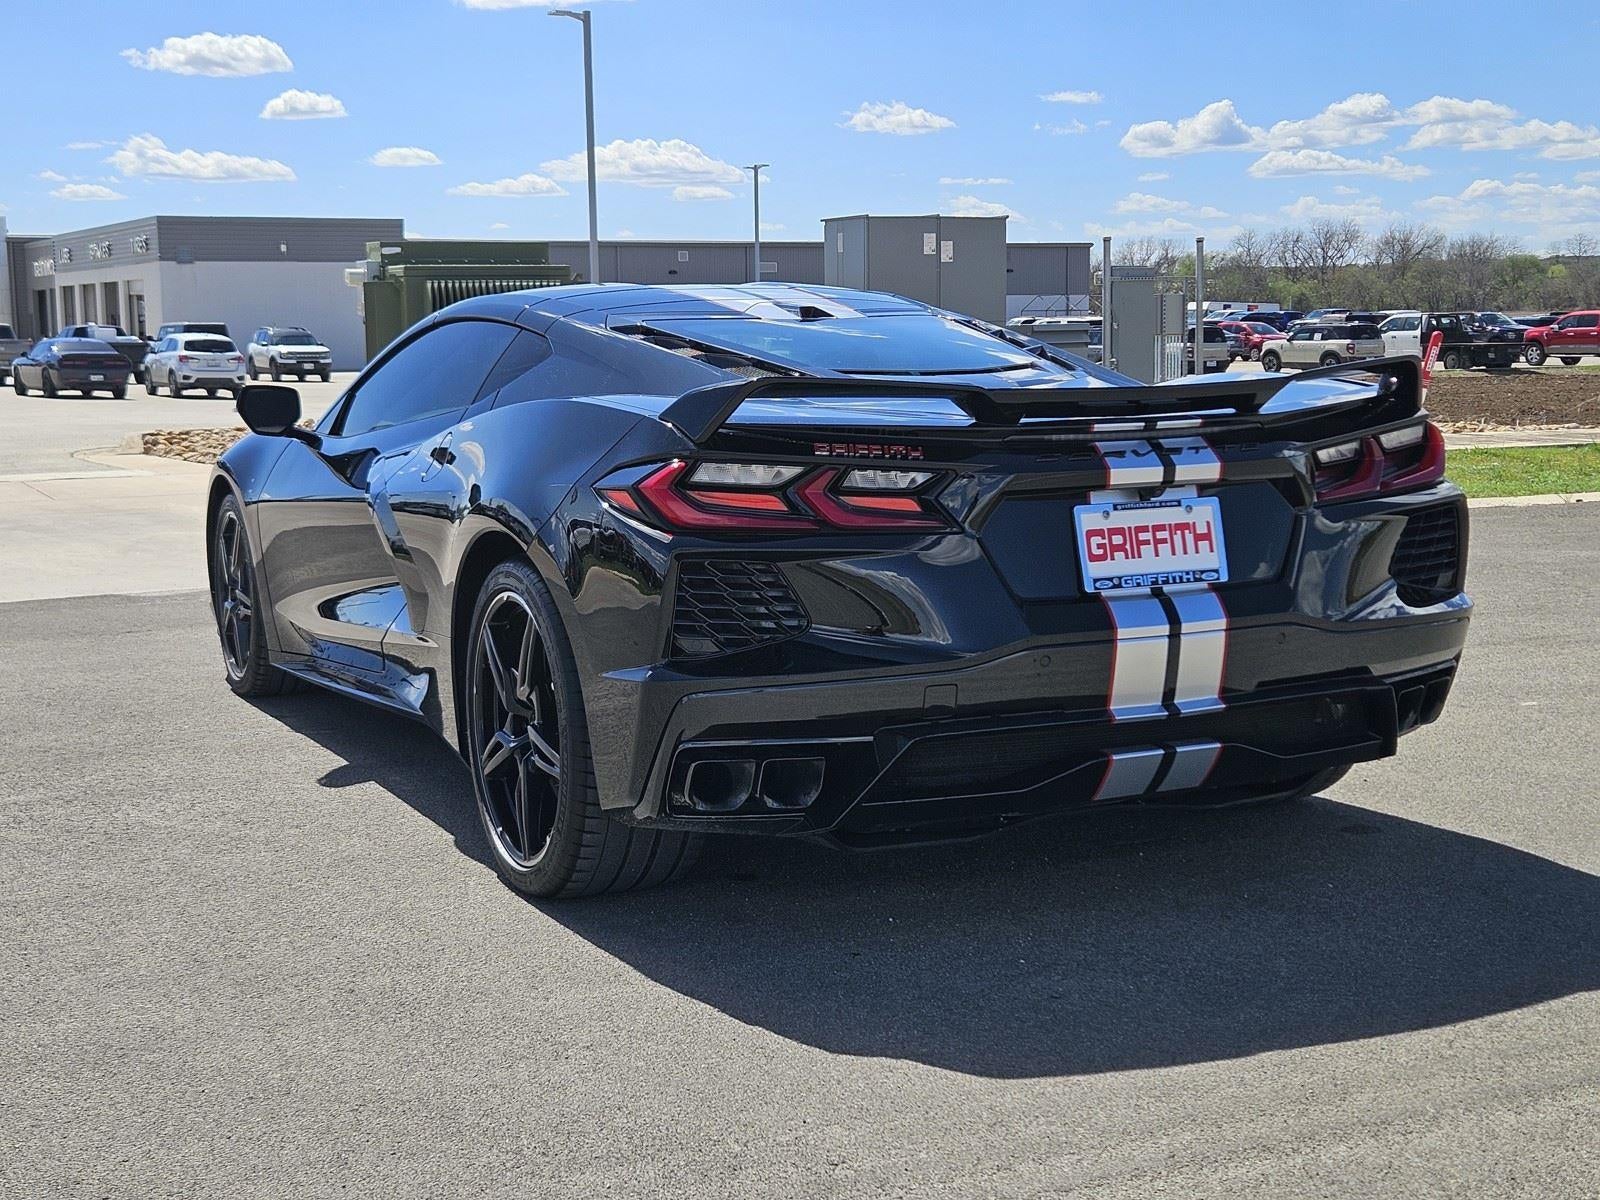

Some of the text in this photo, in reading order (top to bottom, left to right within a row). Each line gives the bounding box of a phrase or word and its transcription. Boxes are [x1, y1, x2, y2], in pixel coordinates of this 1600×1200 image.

[813, 443, 924, 460] GRIFFITH
[1085, 520, 1215, 563] GRIFFITH
[1120, 571, 1194, 588] GRIFFITH
